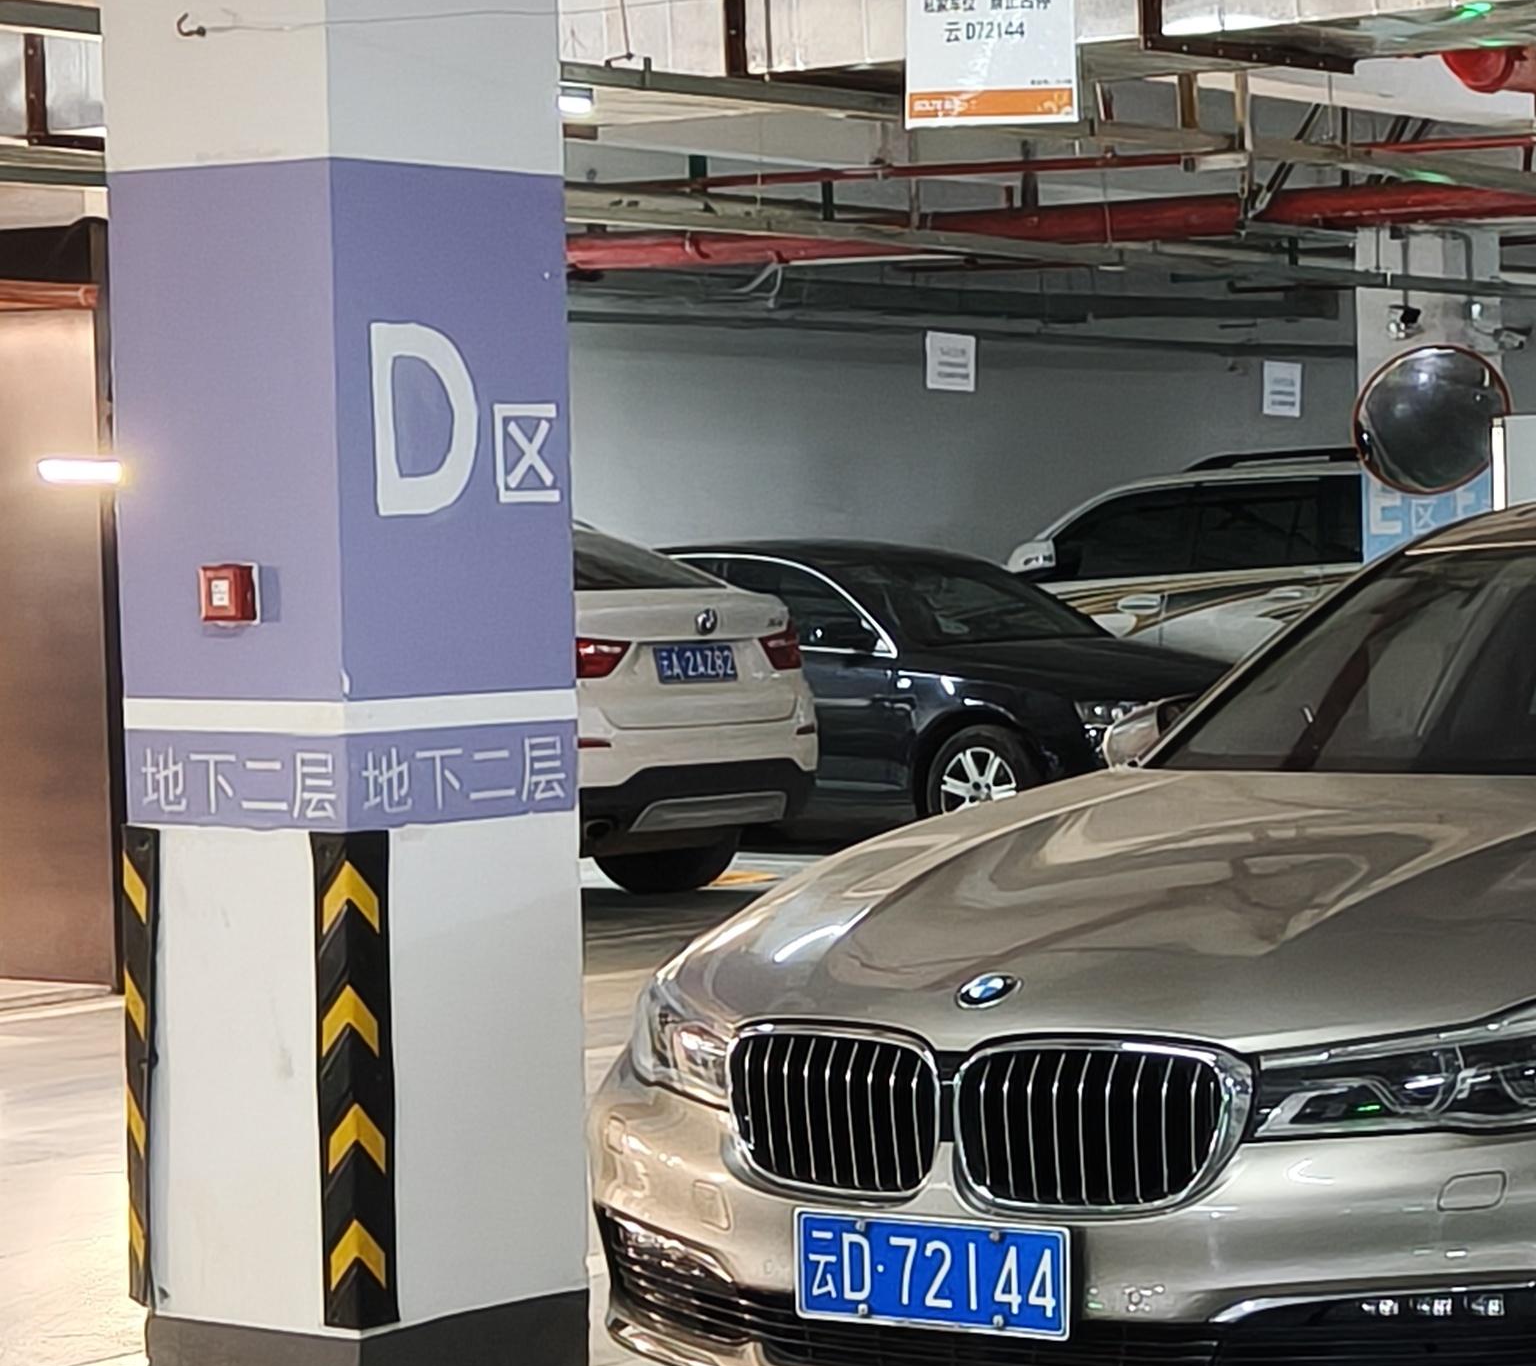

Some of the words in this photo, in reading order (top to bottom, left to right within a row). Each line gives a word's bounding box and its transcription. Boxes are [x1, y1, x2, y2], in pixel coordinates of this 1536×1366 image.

[965, 20, 1025, 41] D72144
[140, 746, 339, 823] 地下二层
[361, 736, 569, 814] 地下二层
